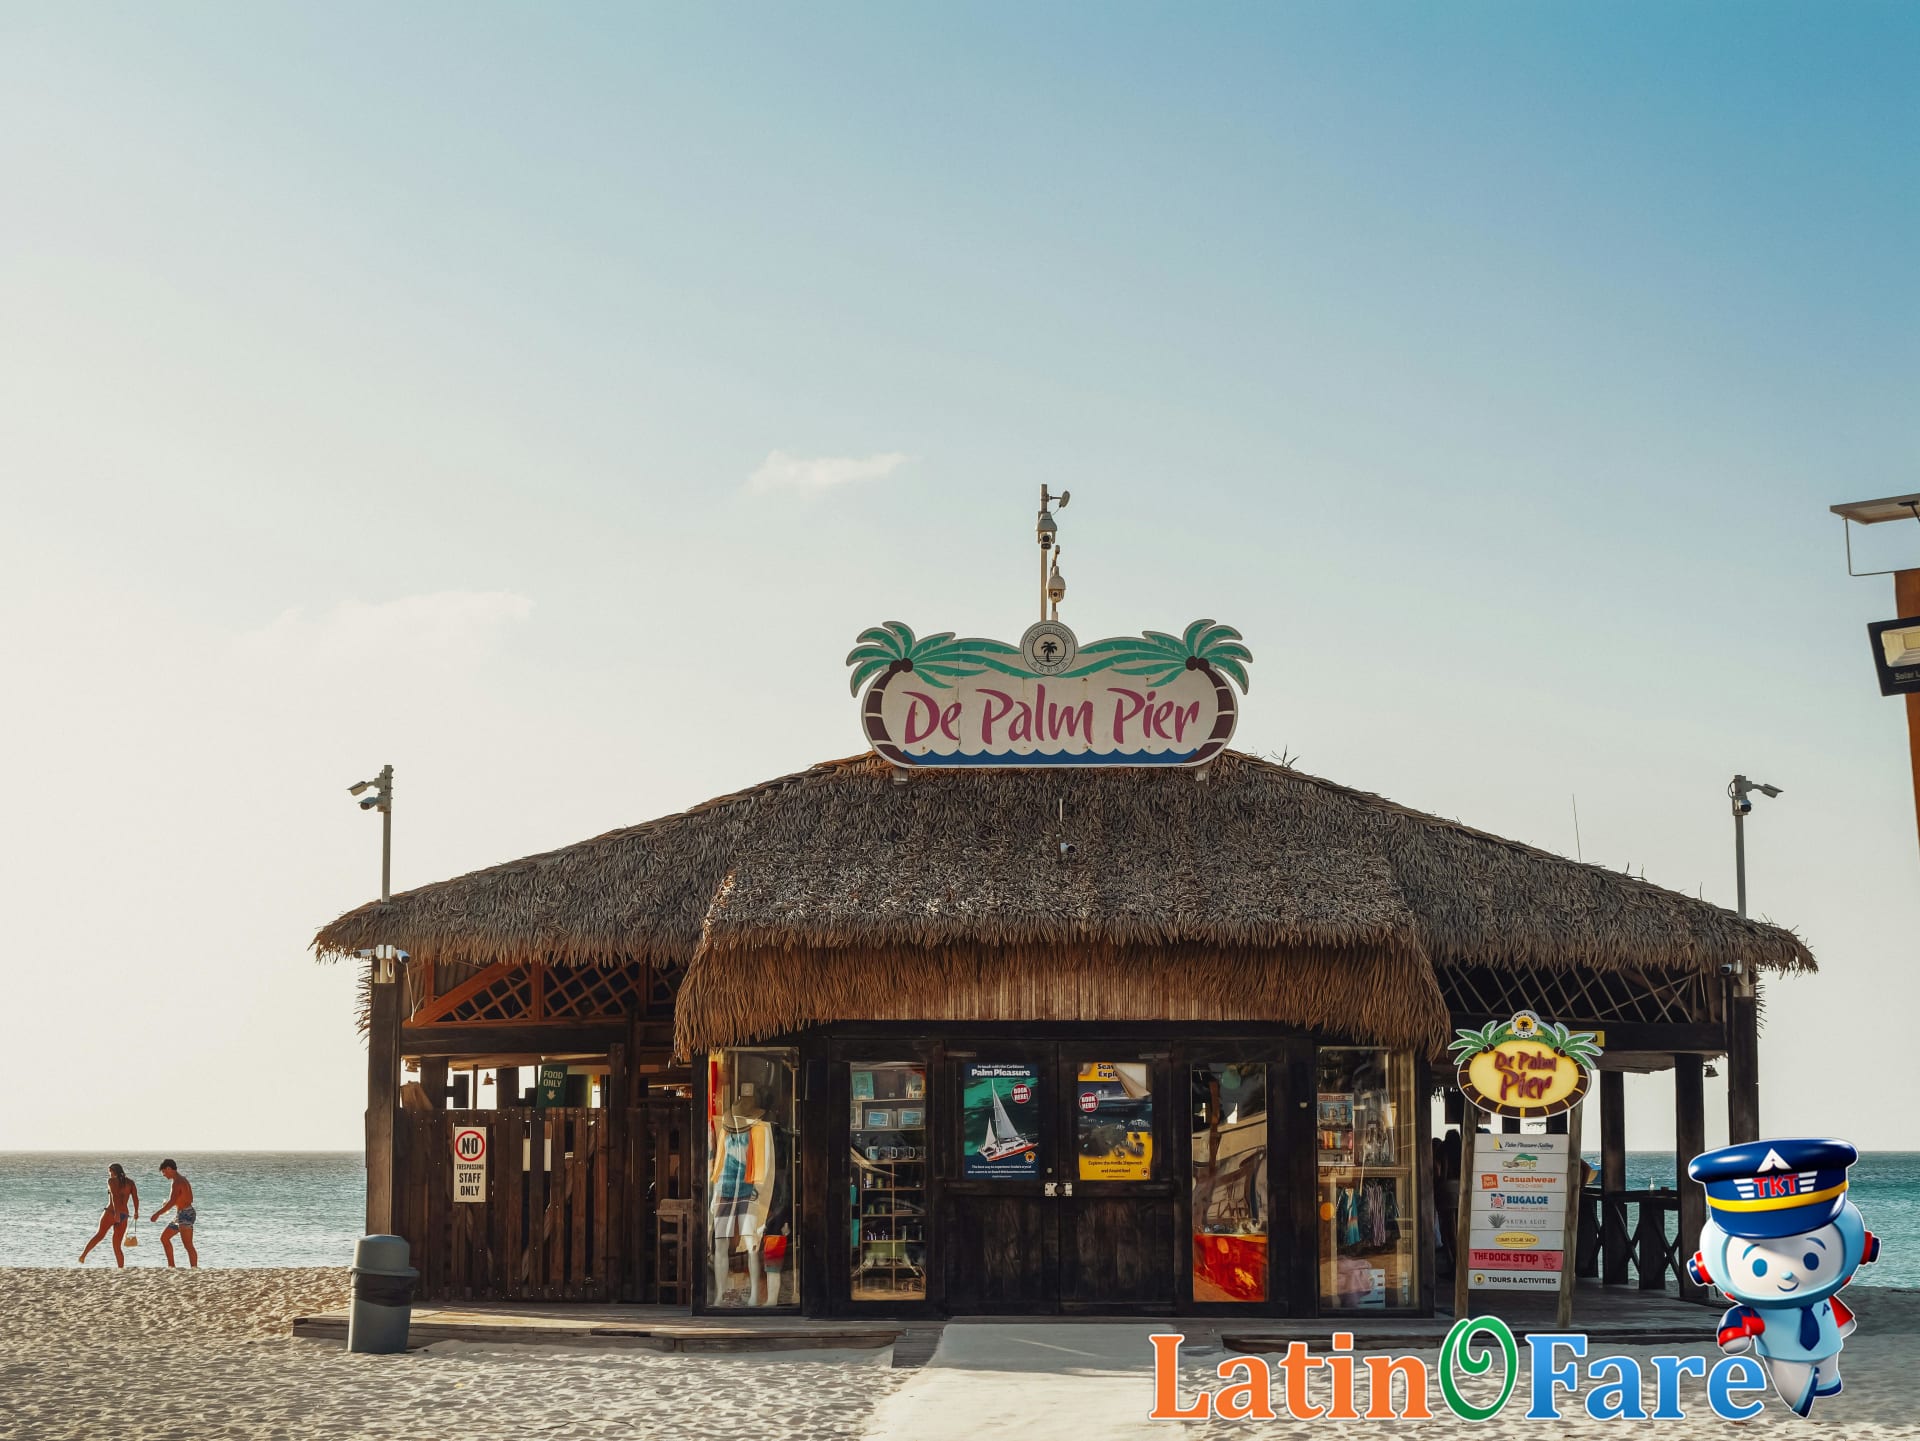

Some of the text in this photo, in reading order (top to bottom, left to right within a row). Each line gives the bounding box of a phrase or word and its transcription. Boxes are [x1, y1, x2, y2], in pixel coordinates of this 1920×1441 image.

[1894, 671, 1914, 681] Solar
[901, 684, 1200, 745] De Palm Pier
[1494, 1051, 1557, 1072] De Palm
[543, 1070, 564, 1079] FOOD
[543, 1079, 562, 1088] ONLY
[1499, 1068, 1553, 1100] Pier
[461, 1137, 479, 1155] NO
[459, 1172, 481, 1184] STAFF
[1502, 1175, 1557, 1184] Casualwear
[460, 1185, 480, 1197] ONLY
[1506, 1195, 1549, 1205] BUGALOE
[1473, 1252, 1489, 1260] THE
[1488, 1252, 1512, 1262] DOCK
[1513, 1253, 1539, 1265] STOP
